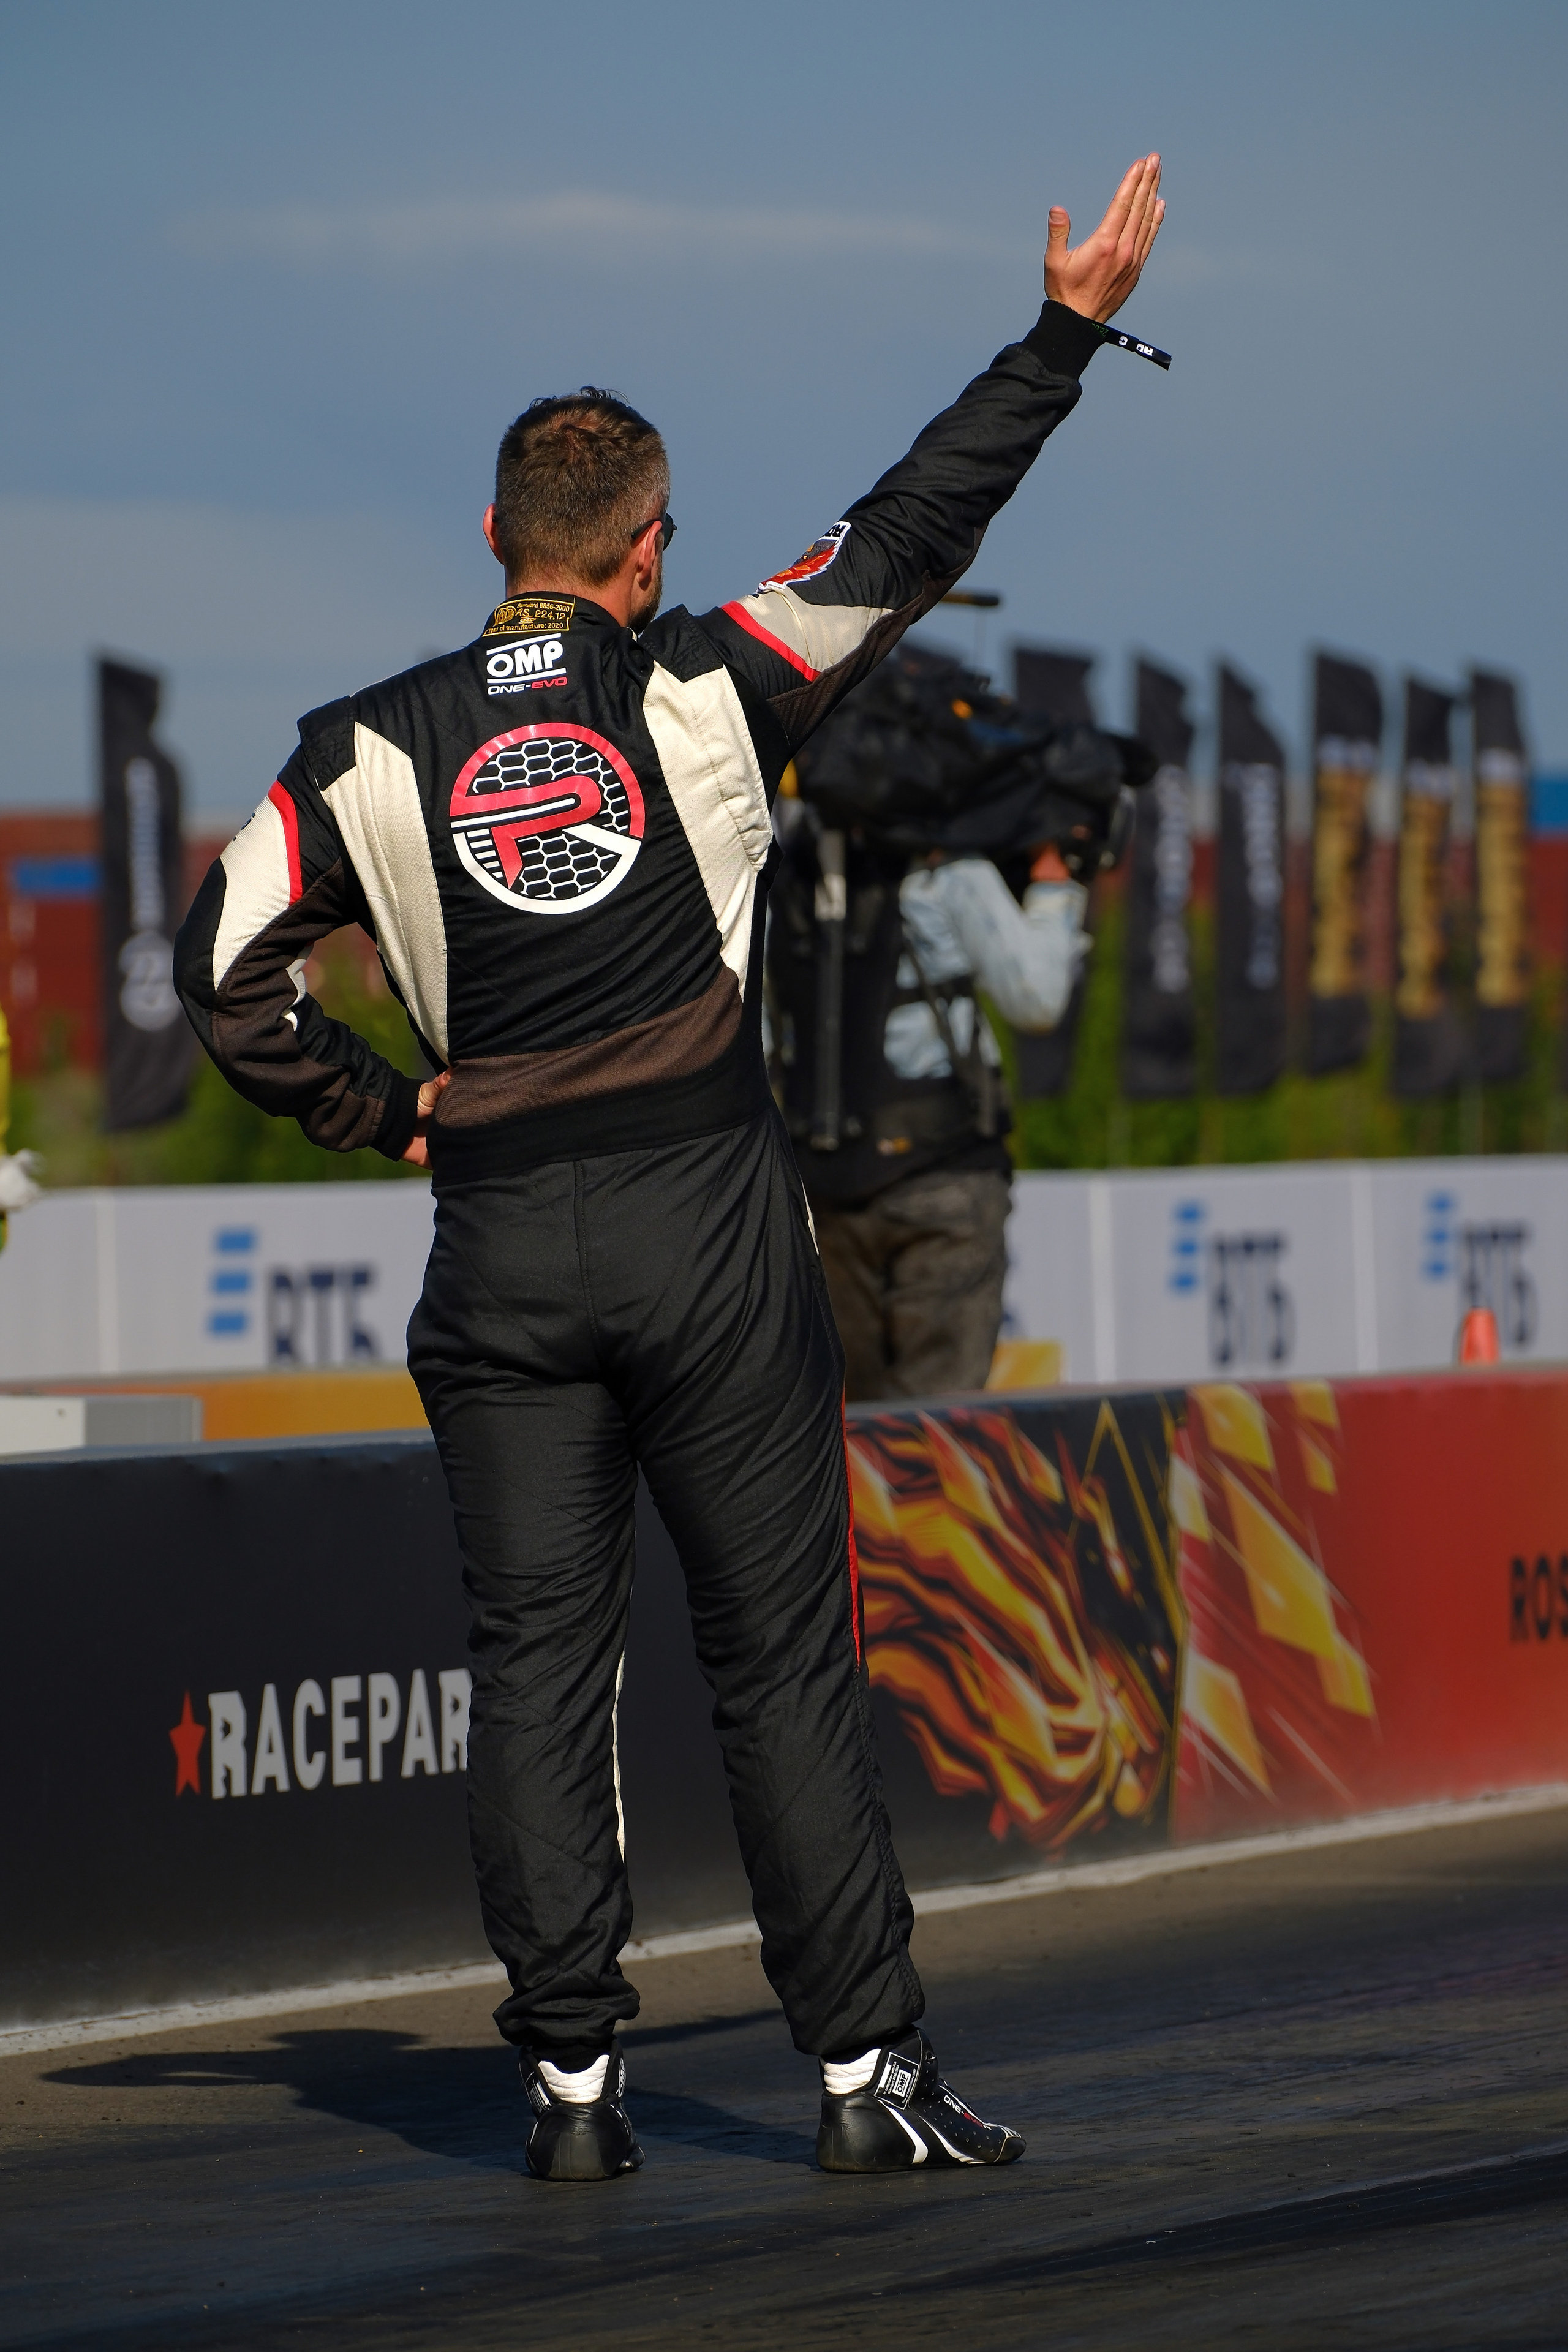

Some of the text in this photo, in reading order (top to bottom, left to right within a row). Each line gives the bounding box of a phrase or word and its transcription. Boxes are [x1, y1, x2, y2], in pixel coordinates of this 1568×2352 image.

[539, 602, 570, 612] 8856-2000
[486, 640, 564, 677] OMP
[488, 677, 568, 695] ONE-EVO
[208, 1668, 473, 1799] RACEPAR
[897, 2073, 907, 2092] OMP
